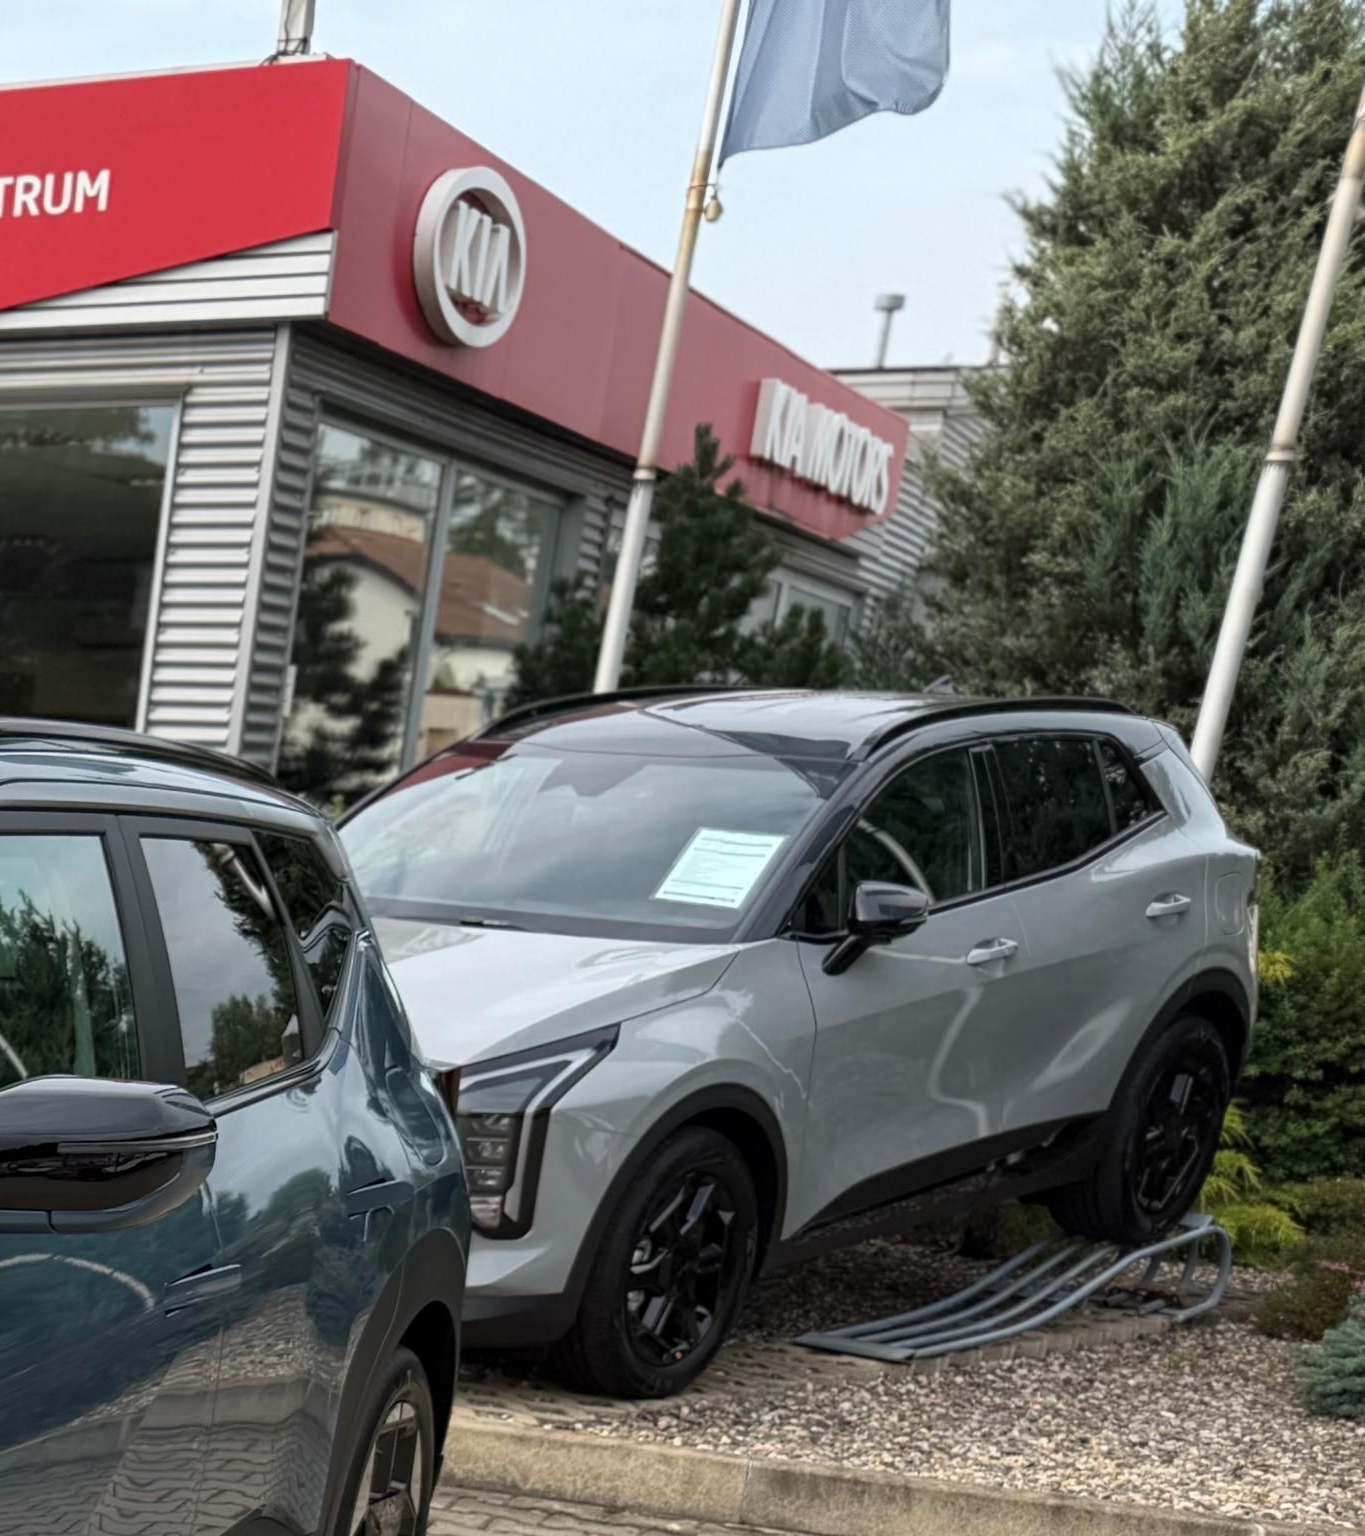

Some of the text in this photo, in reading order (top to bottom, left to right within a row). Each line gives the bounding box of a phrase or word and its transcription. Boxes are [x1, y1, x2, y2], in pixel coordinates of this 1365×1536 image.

[450, 199, 511, 315] KIA
[753, 378, 894, 515] KIA MOTORS
